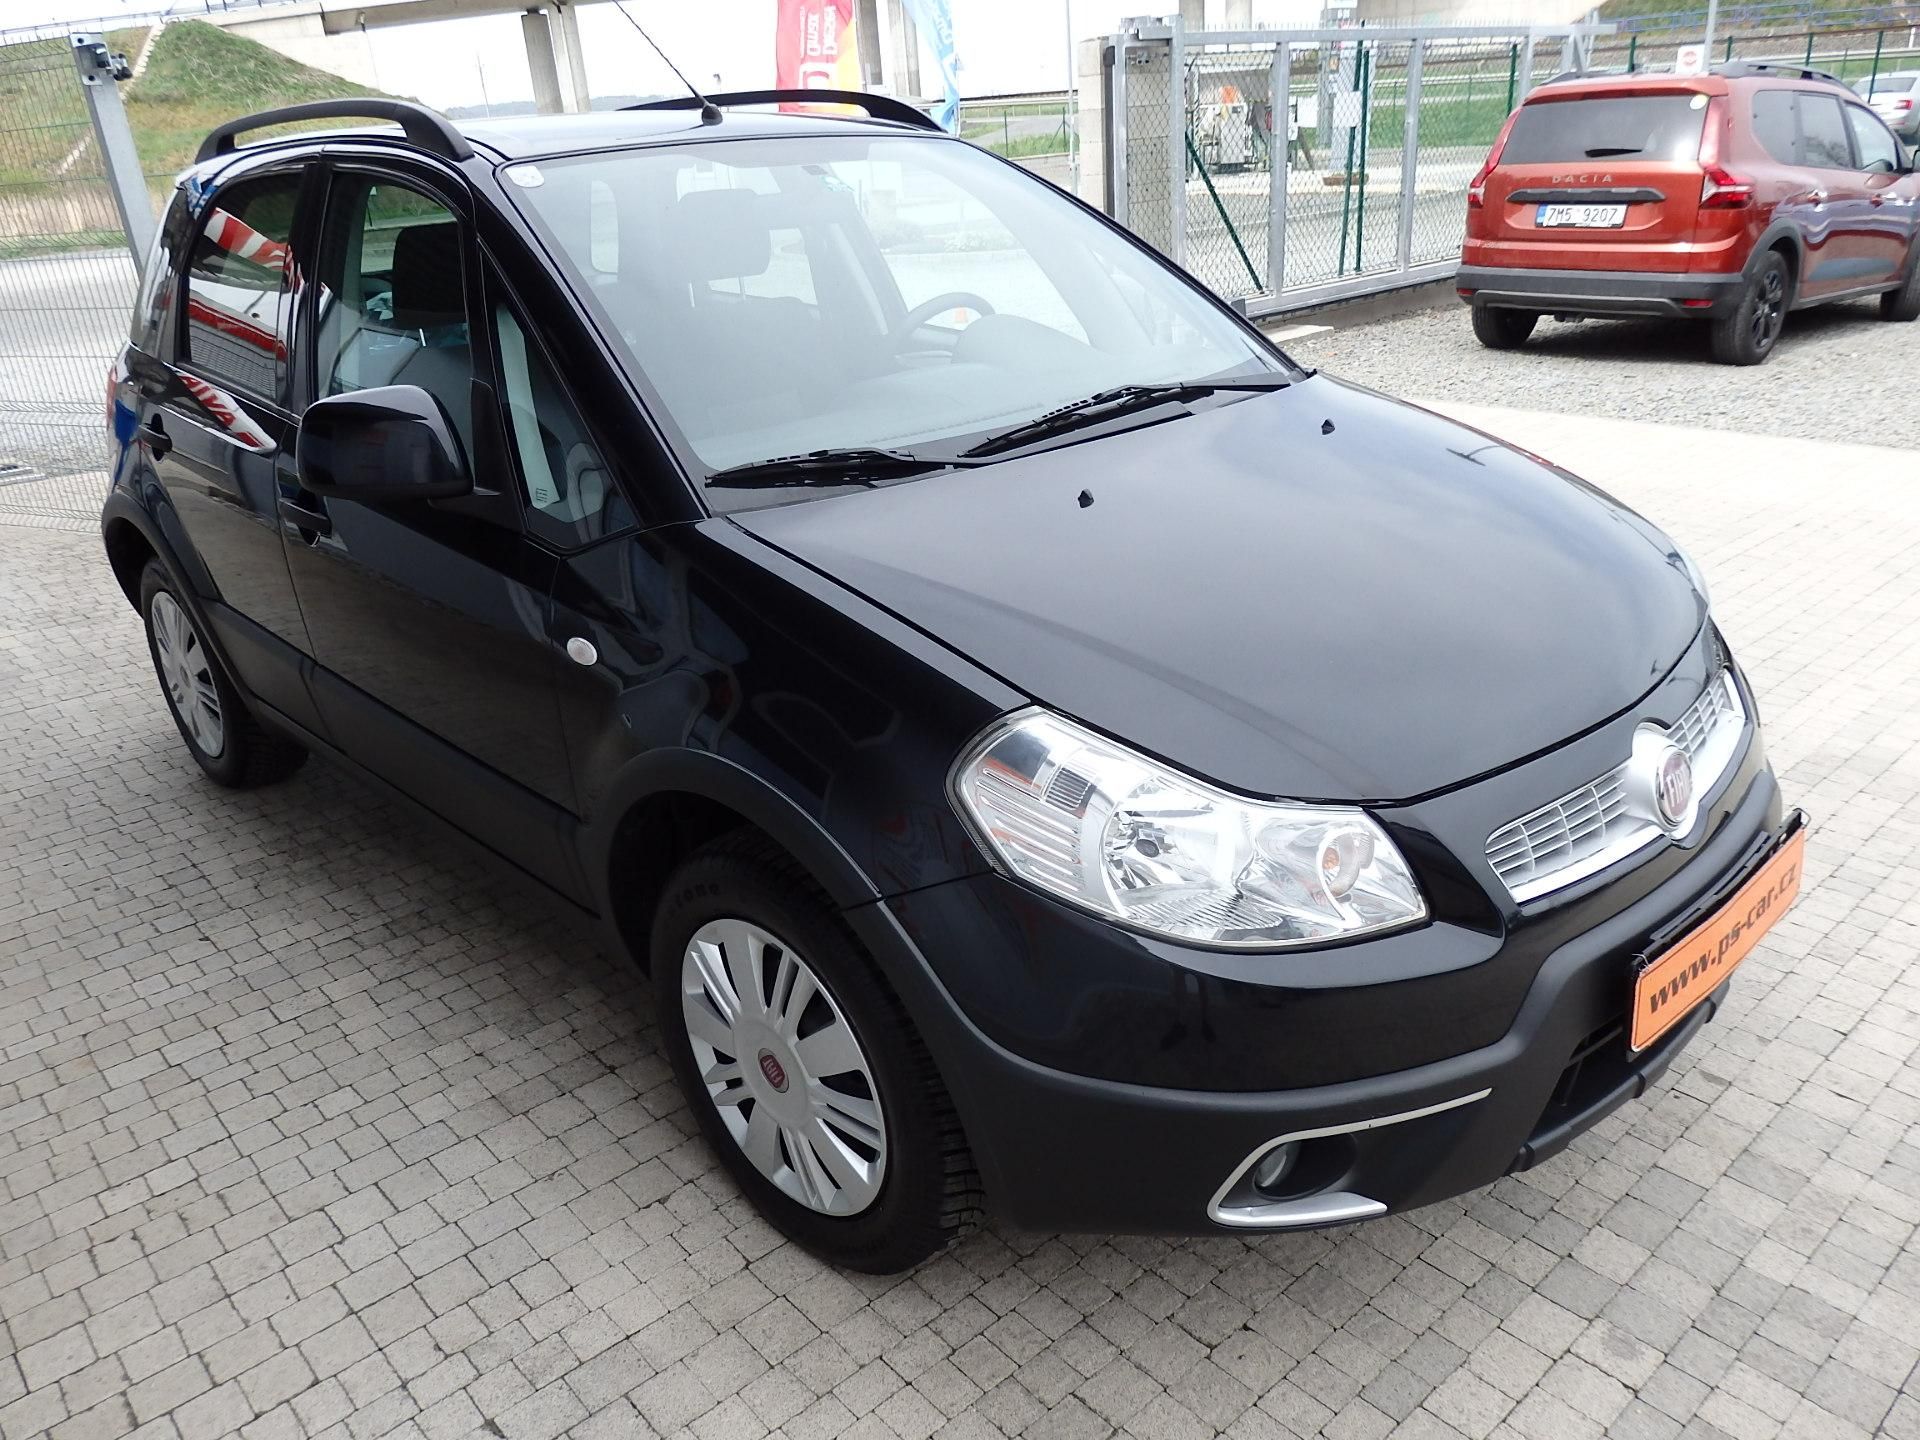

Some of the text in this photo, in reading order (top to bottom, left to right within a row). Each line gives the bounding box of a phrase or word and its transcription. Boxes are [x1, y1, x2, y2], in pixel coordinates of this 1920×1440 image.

[1551, 174, 1613, 184] DACIA
[1549, 207, 1618, 222] 7M5 9207
[1665, 766, 1688, 808] FIAT
[1649, 863, 1797, 1014] www.ps-car.cz
[762, 1058, 785, 1084] FIAT
